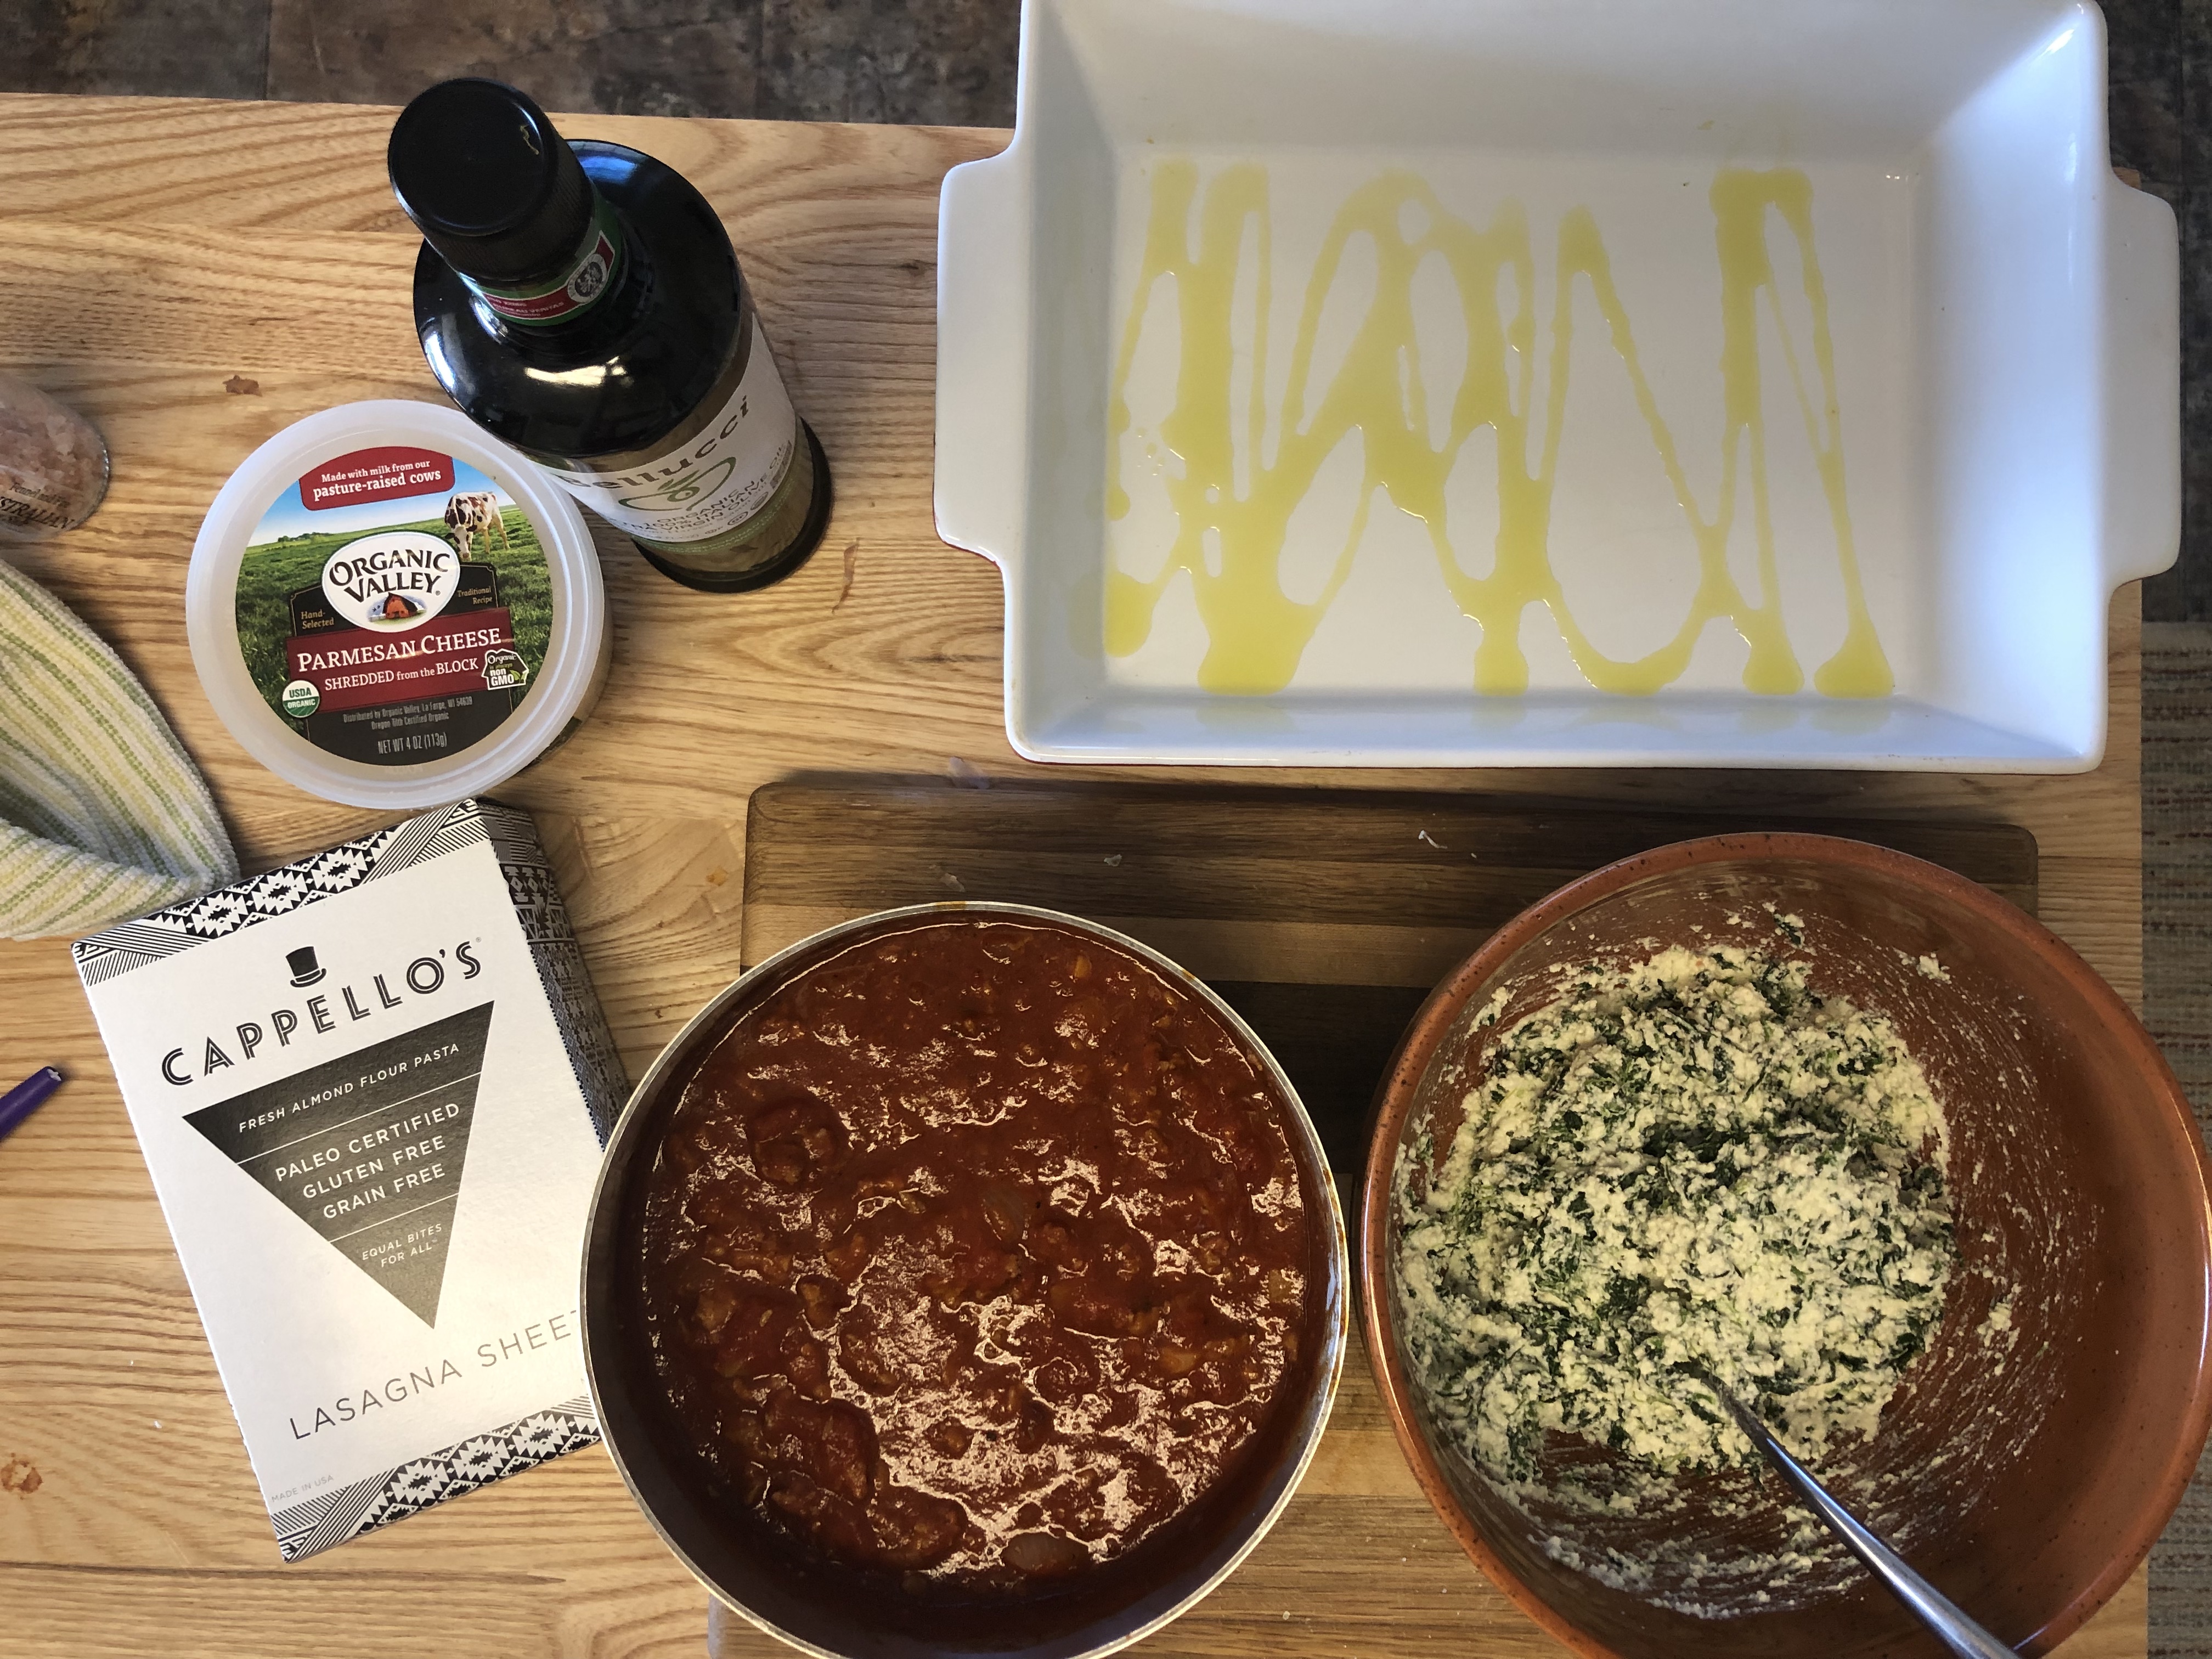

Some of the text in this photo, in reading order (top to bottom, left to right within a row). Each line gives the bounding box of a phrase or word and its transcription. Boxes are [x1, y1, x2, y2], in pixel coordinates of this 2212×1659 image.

[529, 302, 565, 314] VERITAS
[556, 395, 749, 489] Bellucci
[313, 470, 441, 501] pasture-raised cows
[321, 460, 431, 482] Made with milk from our
[0, 496, 75, 529] STRALIAN
[657, 489, 739, 522] ORGANIC
[661, 512, 724, 531] VIRGIN
[728, 473, 767, 510] OLIVE
[696, 481, 755, 520] ITALIAN
[329, 549, 450, 586] ORGANIC
[344, 572, 442, 603] VALLEY
[457, 586, 492, 597] Traditional
[473, 596, 493, 605] Recipe
[301, 609, 326, 619] Hand-
[302, 617, 335, 630] Selected
[297, 628, 501, 672] PARMESAN CHEESE
[488, 654, 517, 664] Organic
[325, 657, 479, 691] SHREDDED from the BLOCK
[490, 668, 506, 676] non
[491, 674, 515, 686] GMO
[287, 698, 315, 709] ORGANIC
[289, 687, 312, 698] USDA
[343, 712, 374, 723] Distributed
[374, 710, 381, 719] by
[382, 707, 403, 718] Organic
[422, 703, 429, 712] La
[448, 699, 455, 708] WI
[456, 696, 473, 707] 54639
[371, 720, 391, 730] Oregon
[404, 714, 427, 726] Certified
[428, 712, 449, 723] Organic
[377, 731, 447, 754] NET WT 4 OZ (113g)
[162, 941, 481, 1086] CAPPELLO'S
[239, 1043, 459, 1133] FRESH ALMOND FLOUR PASTA
[275, 1103, 460, 1182] PALEO CERTIFIED
[303, 1135, 446, 1199] GLUTEN FREE
[324, 1163, 445, 1219] GRAIN FREE
[362, 1223, 442, 1260] EQUAL BITES
[381, 1243, 432, 1268] FOR ALL
[290, 1310, 577, 1440] LASAGNA SHEE
[272, 1475, 334, 1502] MADE IN USA
